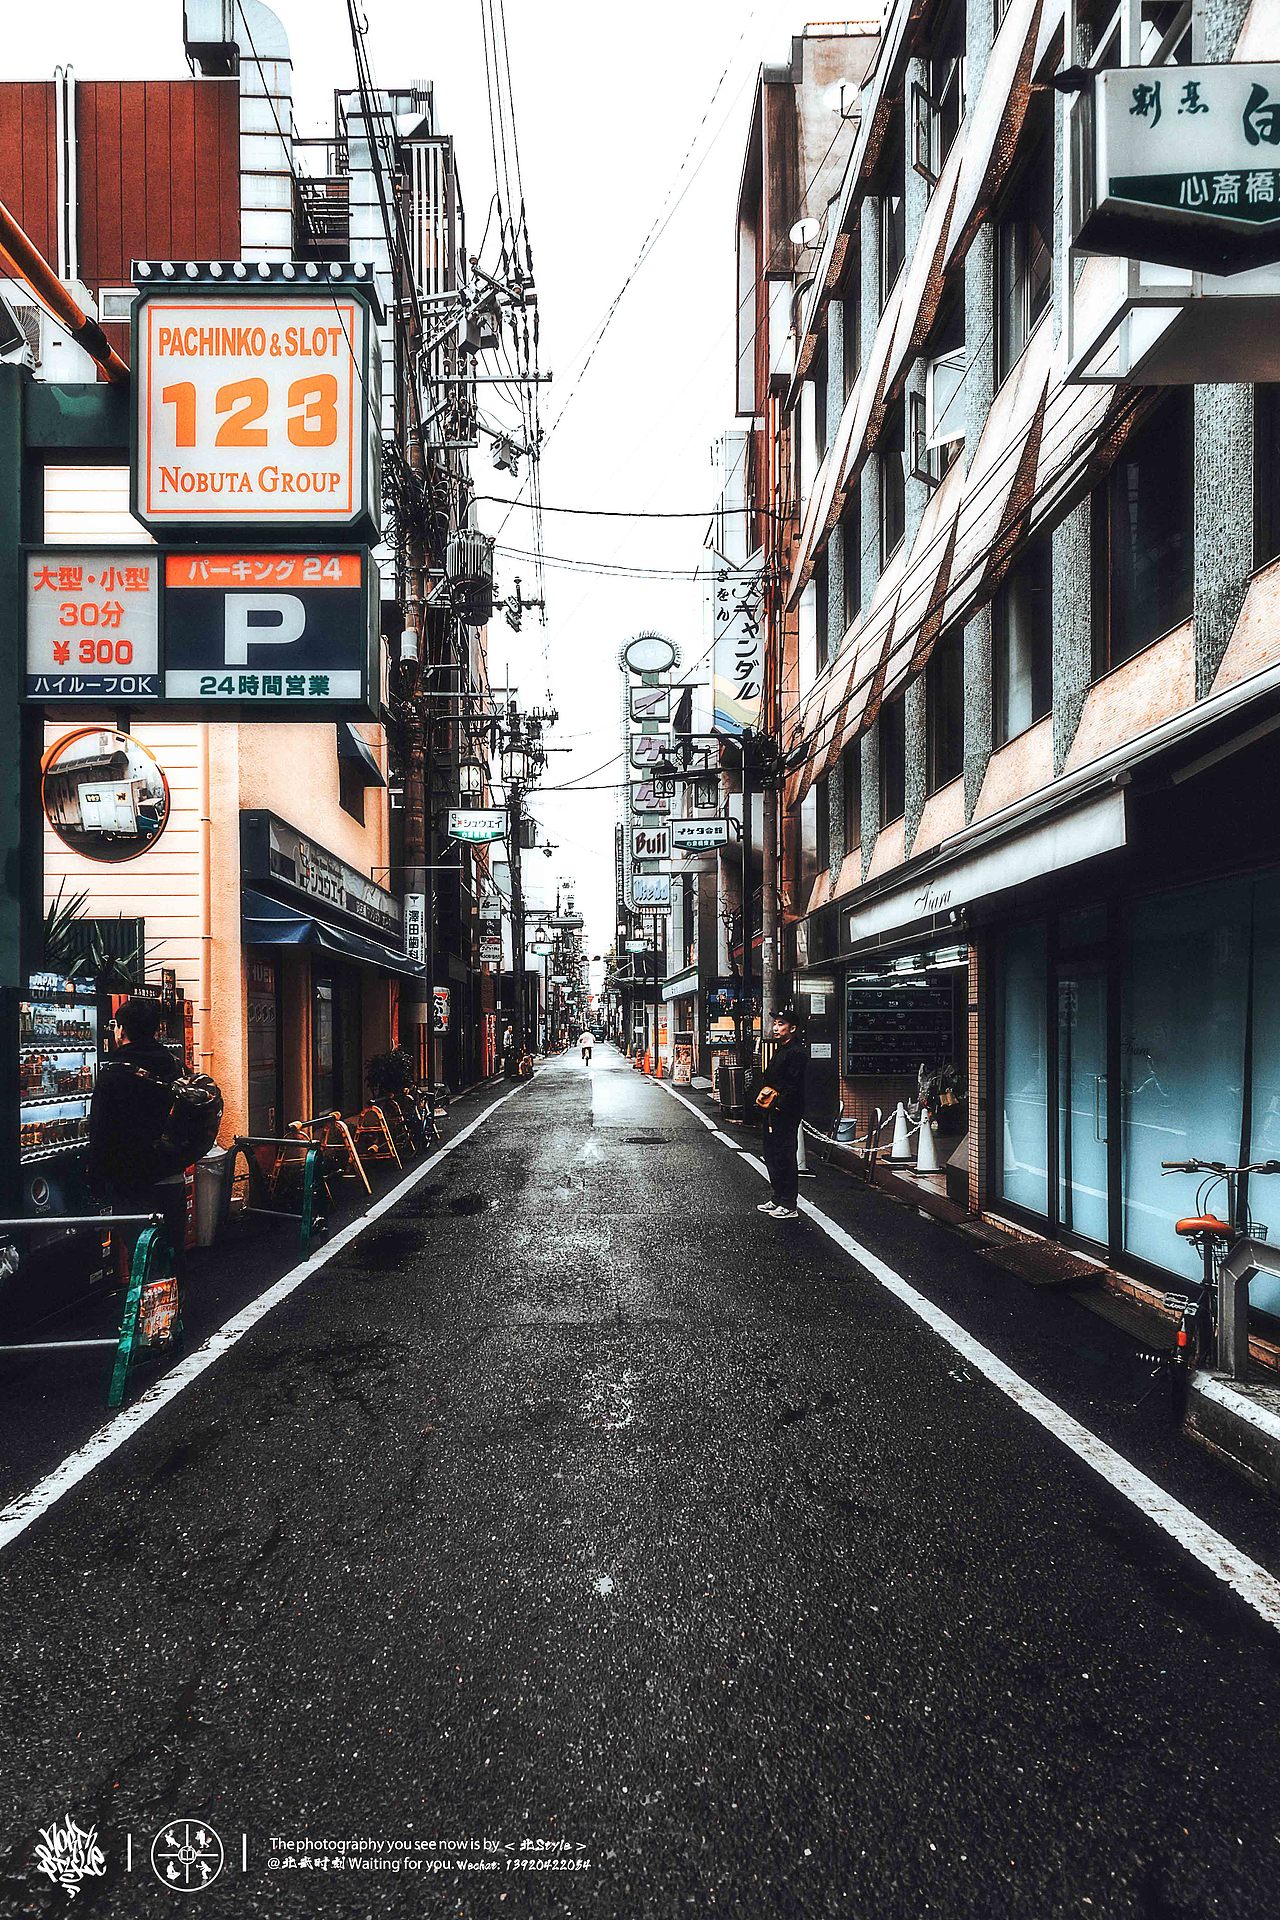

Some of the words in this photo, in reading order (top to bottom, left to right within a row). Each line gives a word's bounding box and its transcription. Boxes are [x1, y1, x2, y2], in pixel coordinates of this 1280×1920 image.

[1180, 171, 1280, 206] 心斎橋
[159, 327, 265, 357] PACHINKO
[270, 333, 282, 356] &
[284, 327, 342, 357] SLOT
[162, 373, 339, 448] 123
[159, 466, 253, 494] NOBUTA
[259, 466, 341, 494] GROUP
[33, 567, 150, 592] 大型・小型
[188, 560, 296, 582] パーキング
[303, 558, 343, 581] 24
[59, 602, 125, 628] 30分
[224, 593, 306, 665] P
[34, 676, 153, 694] ハイルーフOK
[200, 674, 330, 696] 24時間営業
